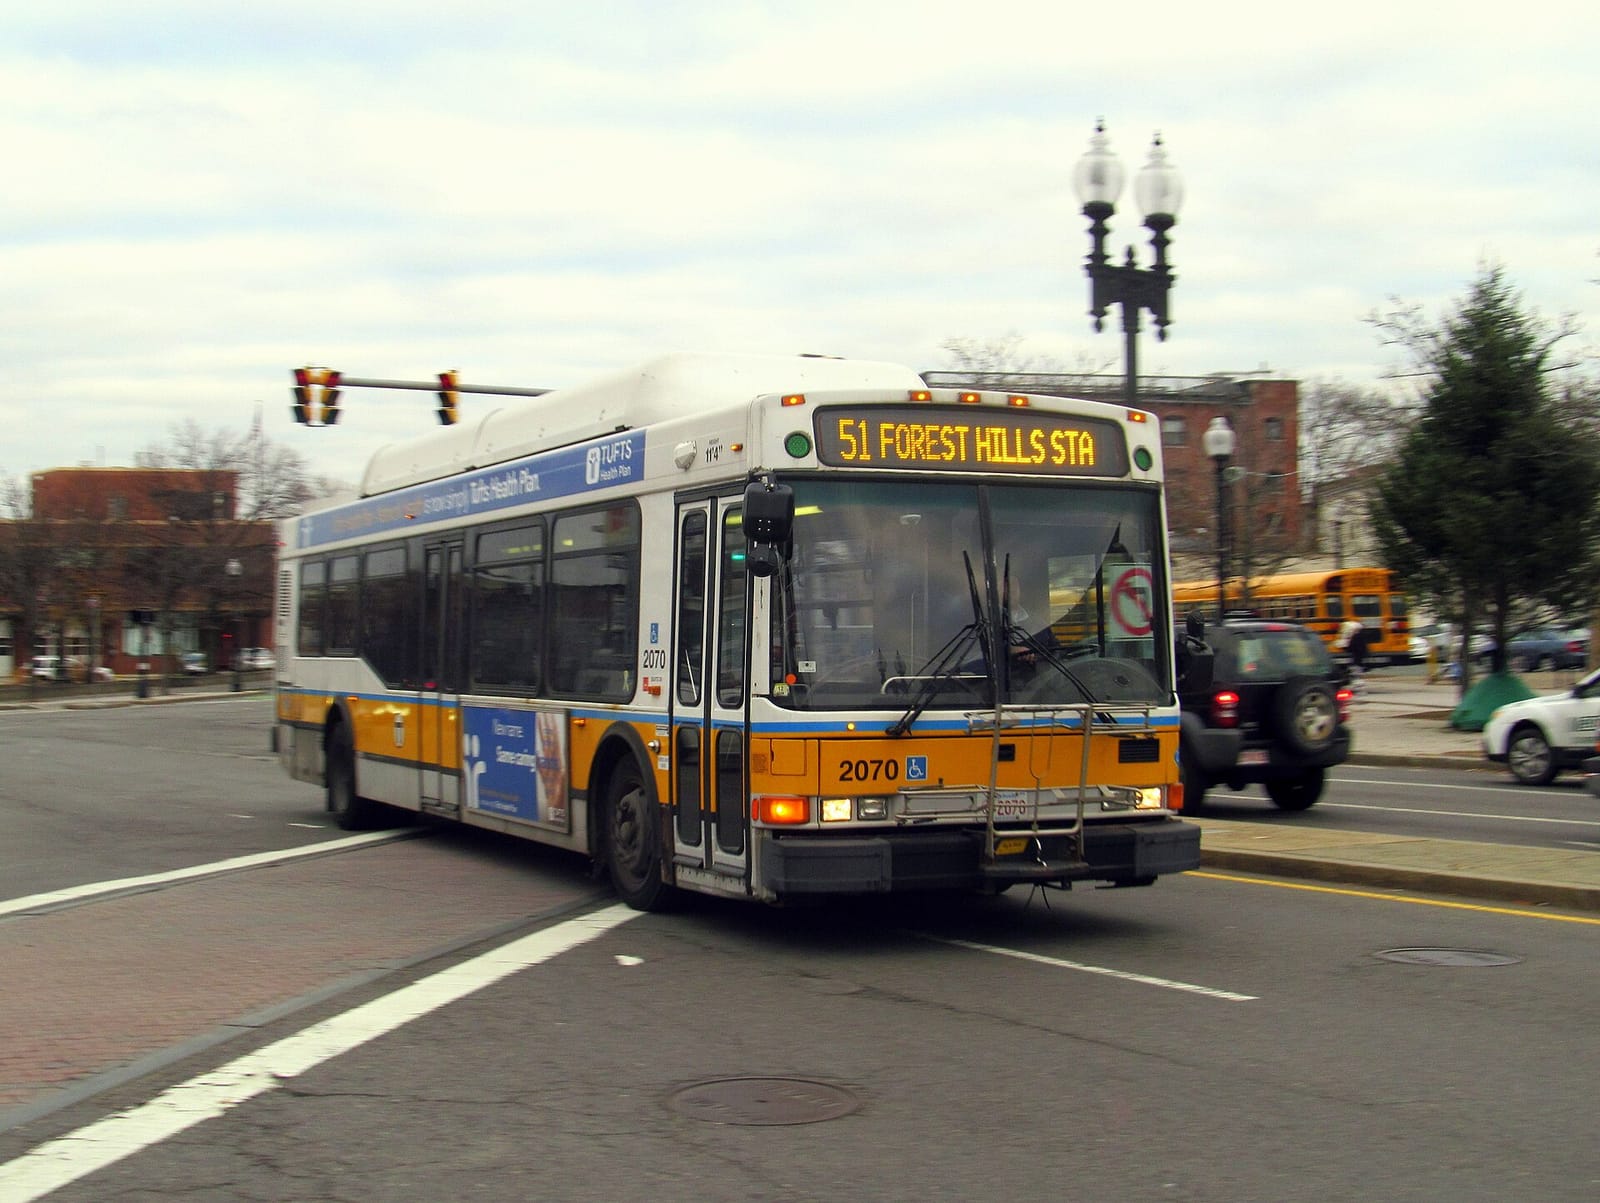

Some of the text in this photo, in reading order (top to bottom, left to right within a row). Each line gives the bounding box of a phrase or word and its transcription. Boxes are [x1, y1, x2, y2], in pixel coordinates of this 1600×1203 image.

[600, 439, 633, 465] TUFTS
[838, 419, 1096, 466] 51 FOREST HILLS STA
[600, 465, 632, 482] Health Plan
[469, 477, 490, 505] Tufts
[490, 469, 518, 500] Health
[643, 650, 666, 670] 2070
[838, 759, 899, 782] 2070
[997, 799, 1026, 816] 2070
